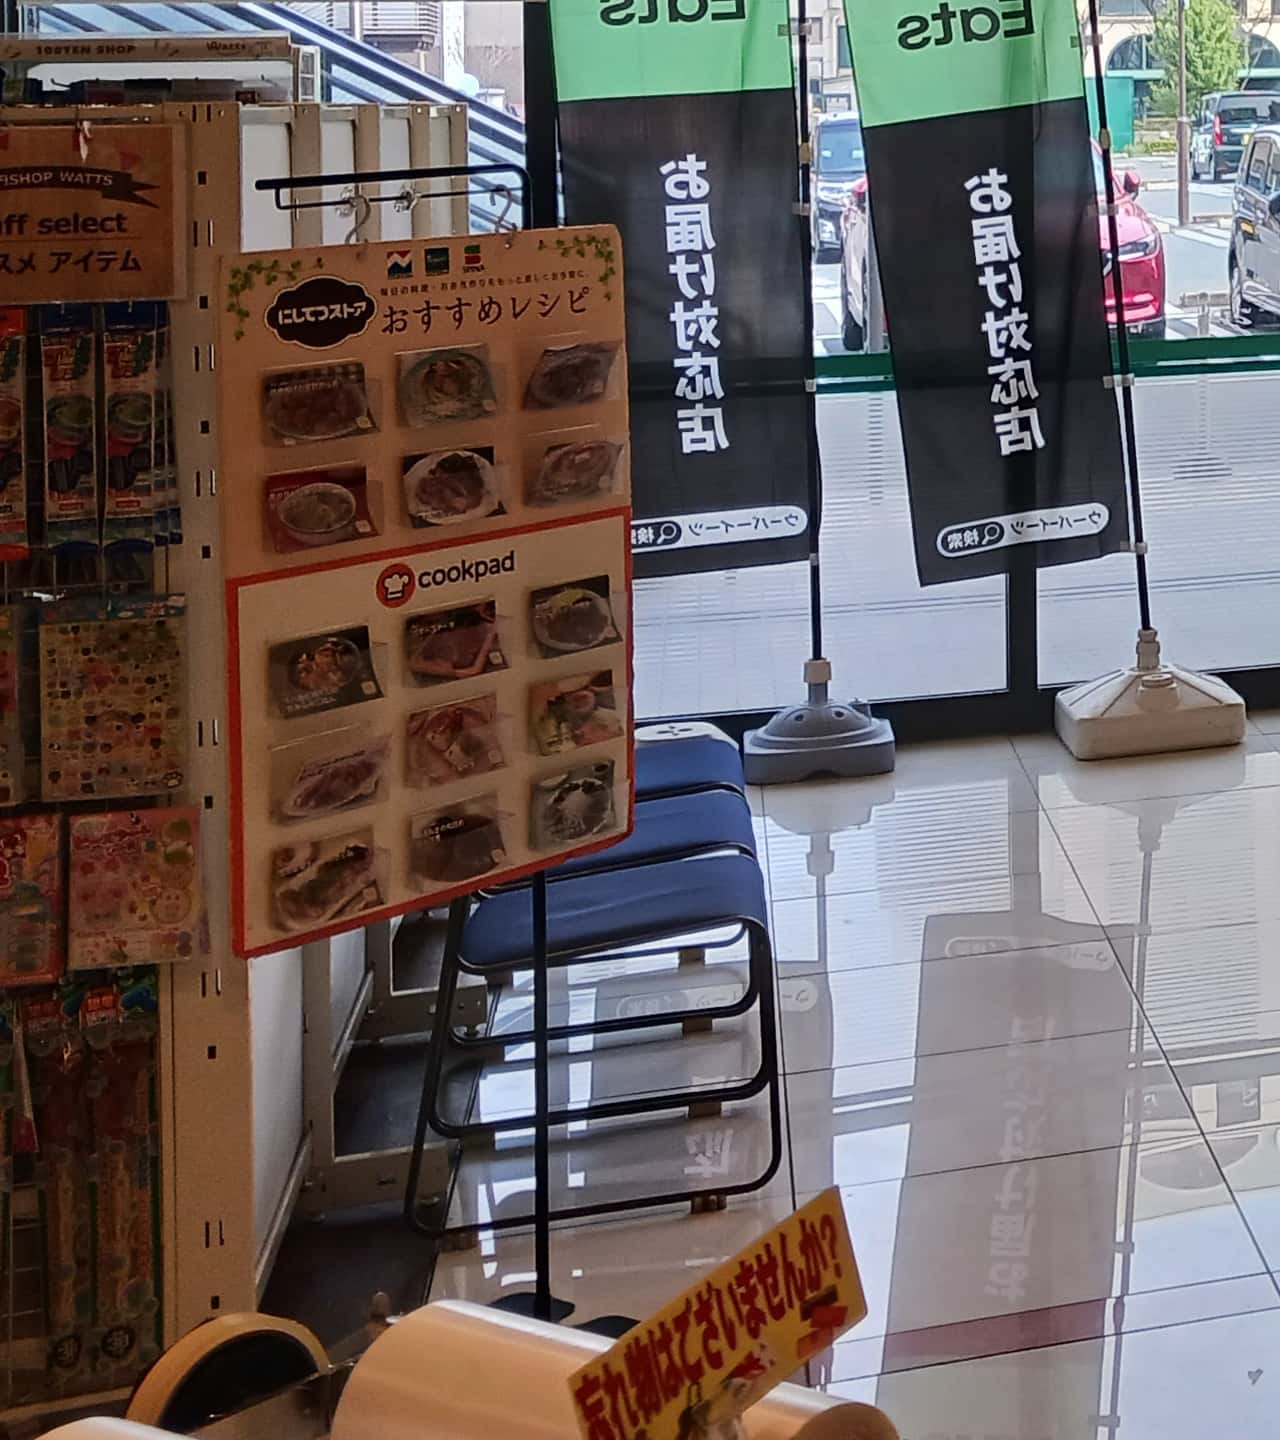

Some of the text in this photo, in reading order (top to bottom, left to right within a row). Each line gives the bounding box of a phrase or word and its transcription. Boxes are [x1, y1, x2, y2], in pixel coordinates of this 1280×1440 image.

[96, 44, 137, 55] SHOP
[60, 171, 113, 186] WATTS
[0, 212, 128, 235] ff select
[50, 249, 142, 273] アイテム
[278, 300, 368, 326] にしてつストア
[381, 286, 593, 335] おすすめレシピ
[417, 550, 516, 588] cookpad
